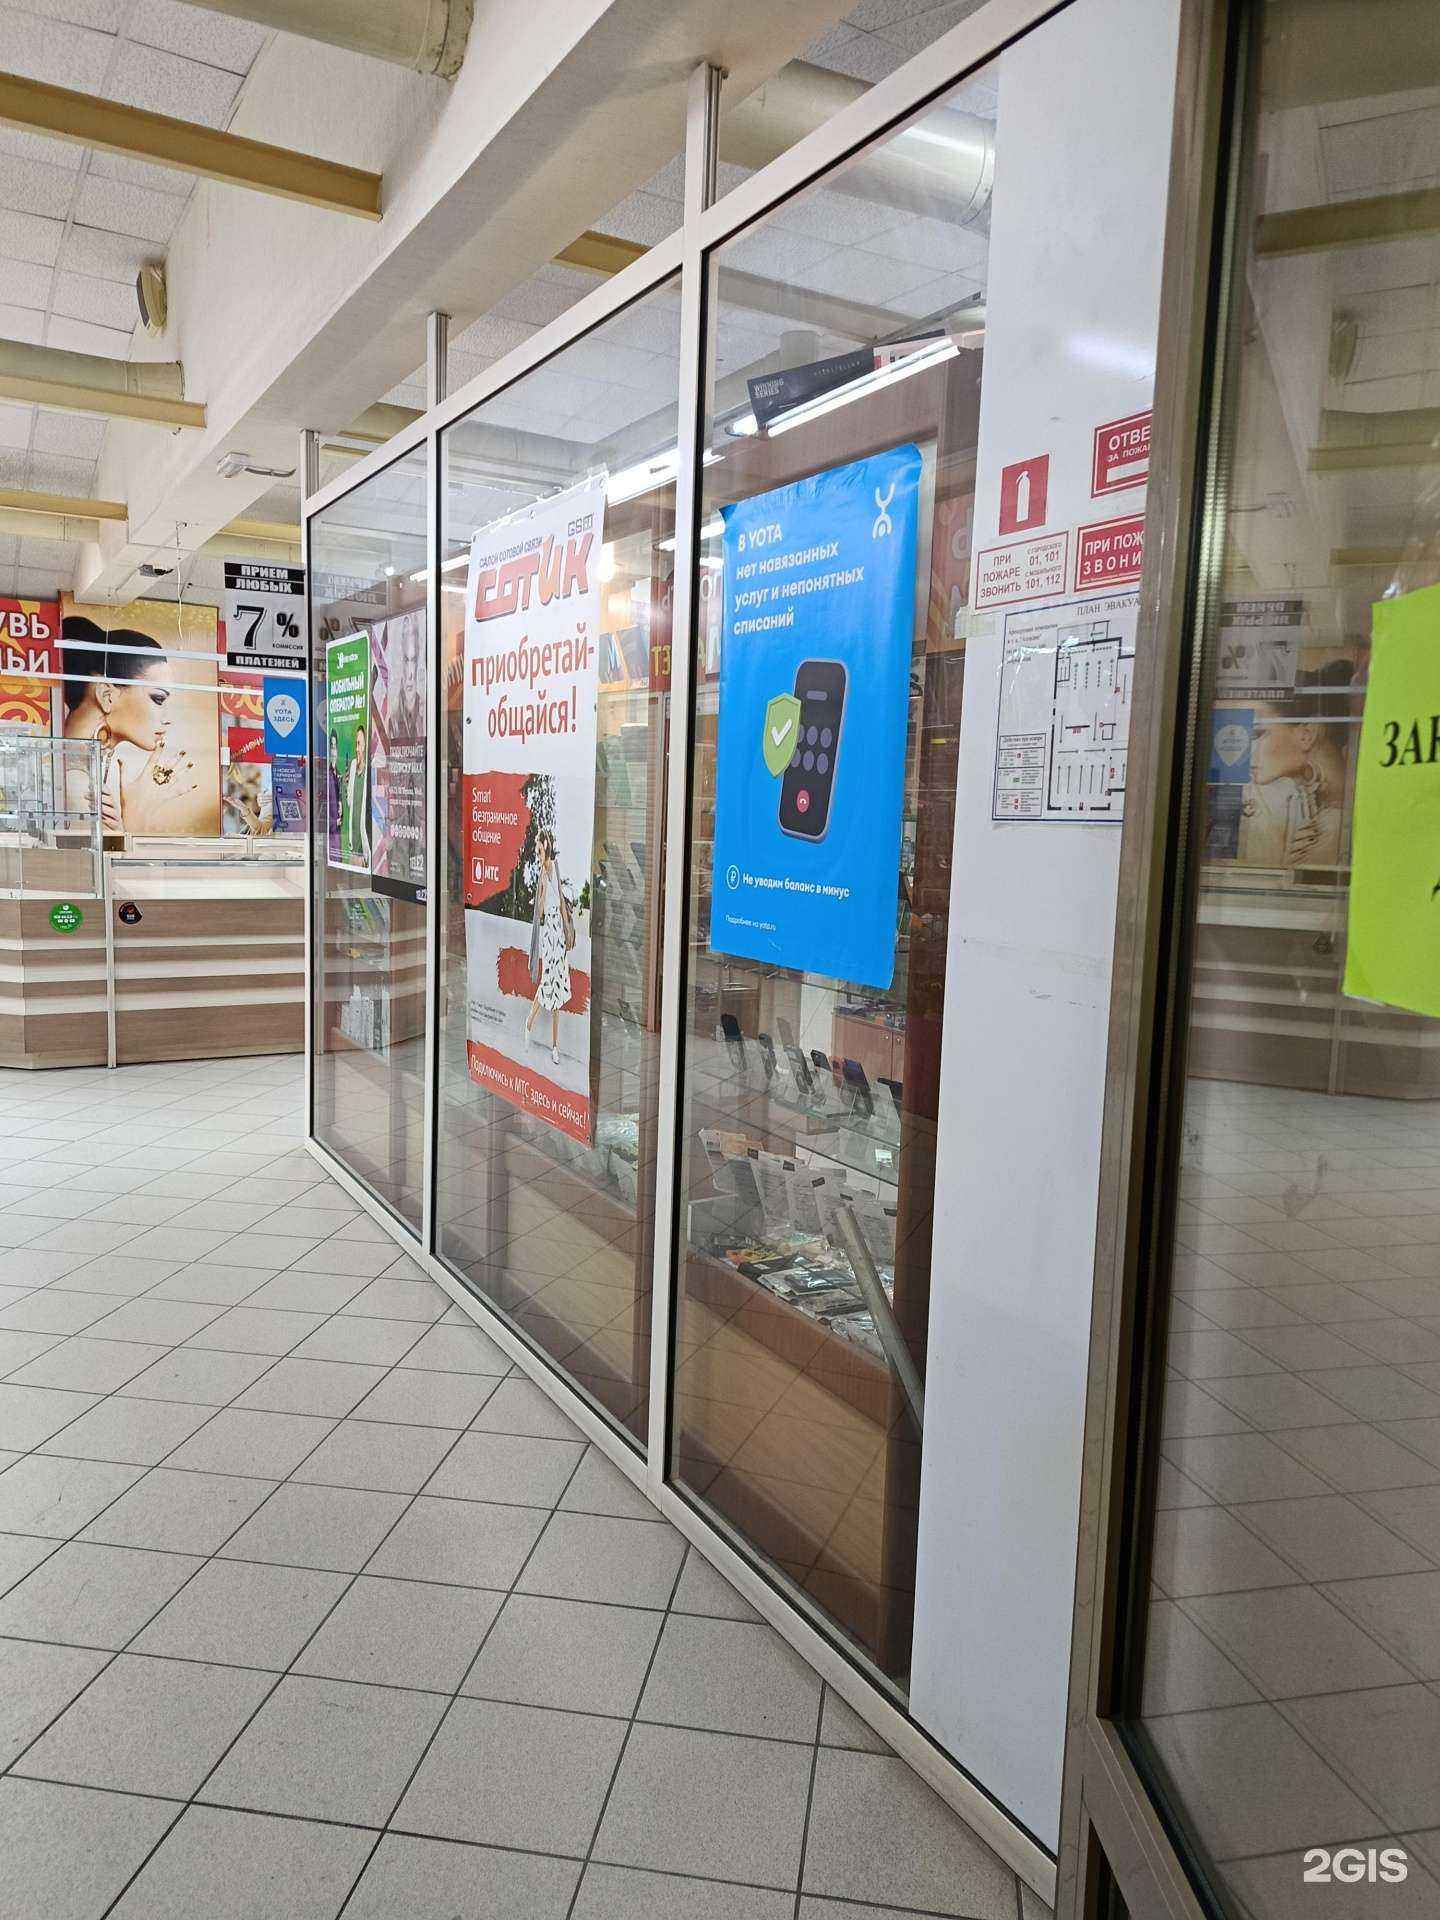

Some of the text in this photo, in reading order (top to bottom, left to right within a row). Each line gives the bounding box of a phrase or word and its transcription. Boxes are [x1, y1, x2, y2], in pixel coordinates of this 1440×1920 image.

[1107, 454, 1119, 463] ЗА
[749, 523, 783, 549] YOTA
[1085, 540, 1111, 556] ПРИ
[736, 542, 839, 580] нет навязанных
[993, 554, 1011, 566] ПРИ
[1029, 550, 1060, 566] 01, 101
[241, 565, 289, 580] ПРИЕМ
[983, 567, 1021, 583] ПОЖАРЕ
[1026, 573, 1061, 589] 101, 112
[235, 578, 293, 593] ЛЮБЫХ
[734, 566, 865, 613] услуг и непонятных
[980, 583, 1022, 598] ЗВОНИТЬ
[1077, 606, 1101, 616] ПЛАН
[233, 605, 267, 651] 7
[733, 606, 795, 636] списаний
[0, 647, 49, 674] ЬИ
[235, 655, 300, 669] ПЛАТЕЖЕЙ
[472, 622, 595, 696] приобретай-
[488, 685, 577, 745] общайся!
[472, 787, 492, 803] Smart
[472, 806, 518, 827] безграничное
[472, 827, 502, 846] общение
[484, 865, 499, 882] МТС
[742, 873, 754, 885] Не
[755, 878, 783, 889] уводим
[784, 878, 815, 893] баланс
[822, 887, 850, 900] минус
[471, 1055, 509, 1087] Подключись
[514, 1077, 530, 1098] МТС
[530, 1088, 551, 1110] здесь
[551, 1100, 557, 1112] и
[558, 1103, 587, 1129] сейчас!
